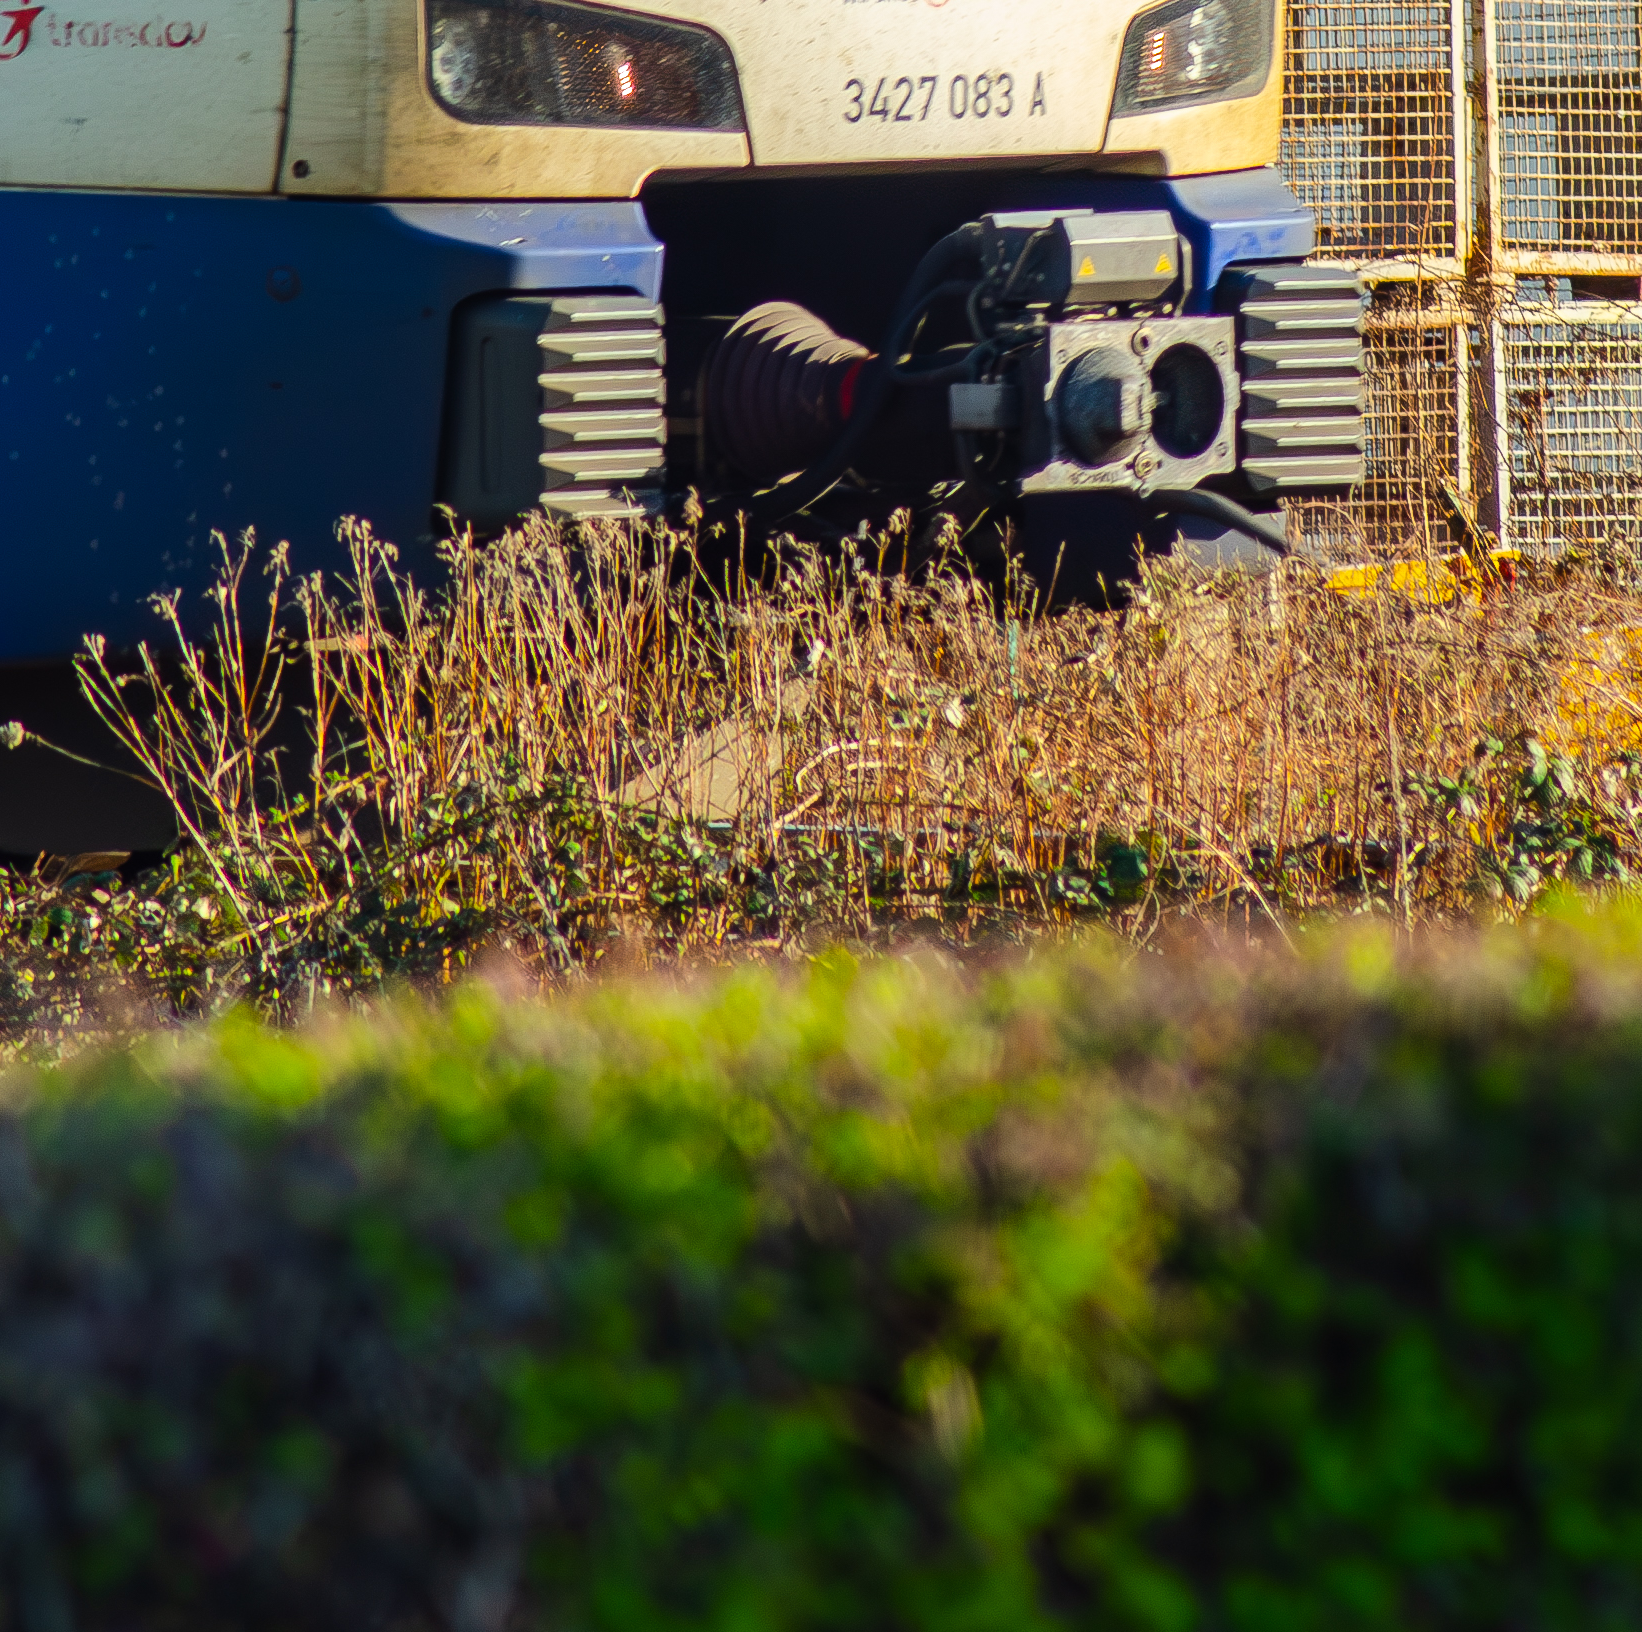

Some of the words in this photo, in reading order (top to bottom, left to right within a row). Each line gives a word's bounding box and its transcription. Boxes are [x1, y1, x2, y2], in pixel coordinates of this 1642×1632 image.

[841, 74, 938, 123] 3427
[949, 71, 1015, 119] 083
[1027, 70, 1048, 117] A
